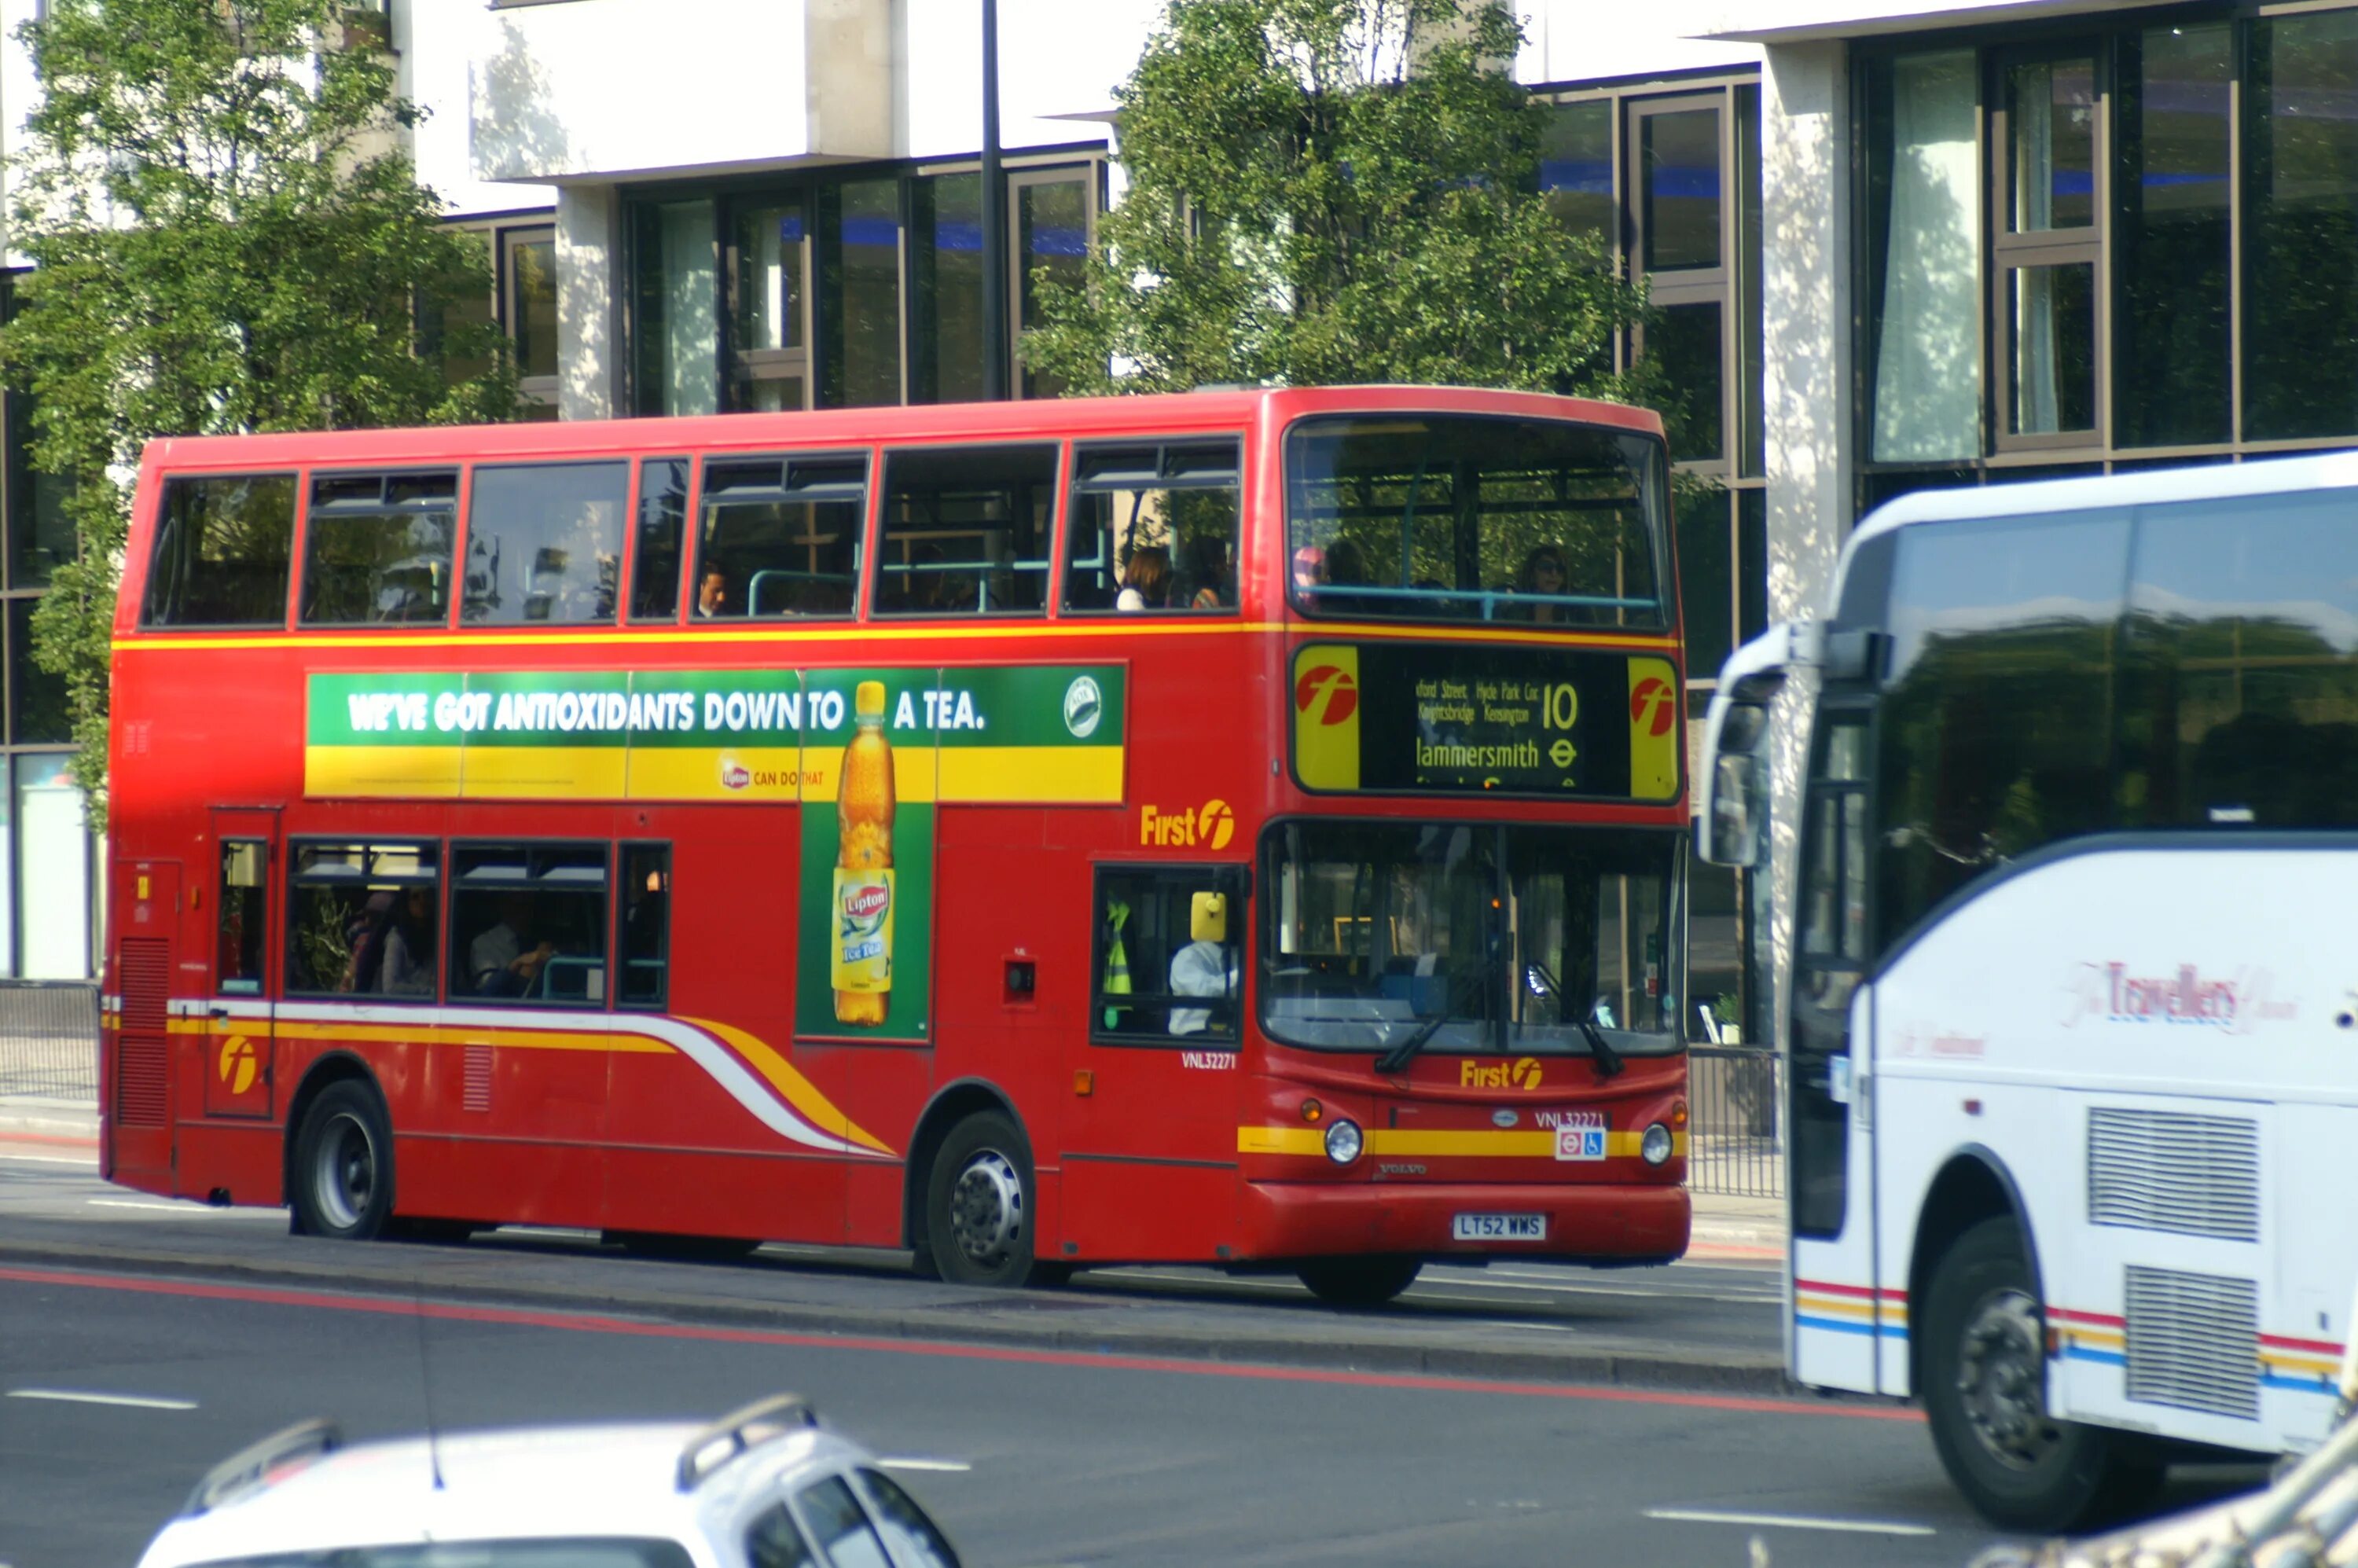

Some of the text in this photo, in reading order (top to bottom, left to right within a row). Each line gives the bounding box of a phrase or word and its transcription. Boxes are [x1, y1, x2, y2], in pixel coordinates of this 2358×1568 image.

[1442, 679, 1467, 699] Street
[1476, 680, 1497, 704] Hyde
[1501, 681, 1521, 700] Park
[348, 691, 984, 732] WE'VE GOT ANTIOXIDANTS DOWN TO A TEA.
[1419, 702, 1530, 727] Knightsbridge Kensington
[1543, 683, 1578, 729] 10
[755, 772, 776, 785] CAN
[780, 772, 798, 785] DO
[802, 771, 823, 785] THAT
[1140, 805, 1195, 846] First
[847, 891, 886, 914] Lipton
[843, 946, 861, 963] Ice
[1182, 1052, 1236, 1070] VNL32271
[1460, 1059, 1510, 1089] First
[1535, 1111, 1604, 1128] VNL32271
[1379, 1164, 1427, 1175] VOLVO
[1461, 1217, 1540, 1236] LT52 WWS
